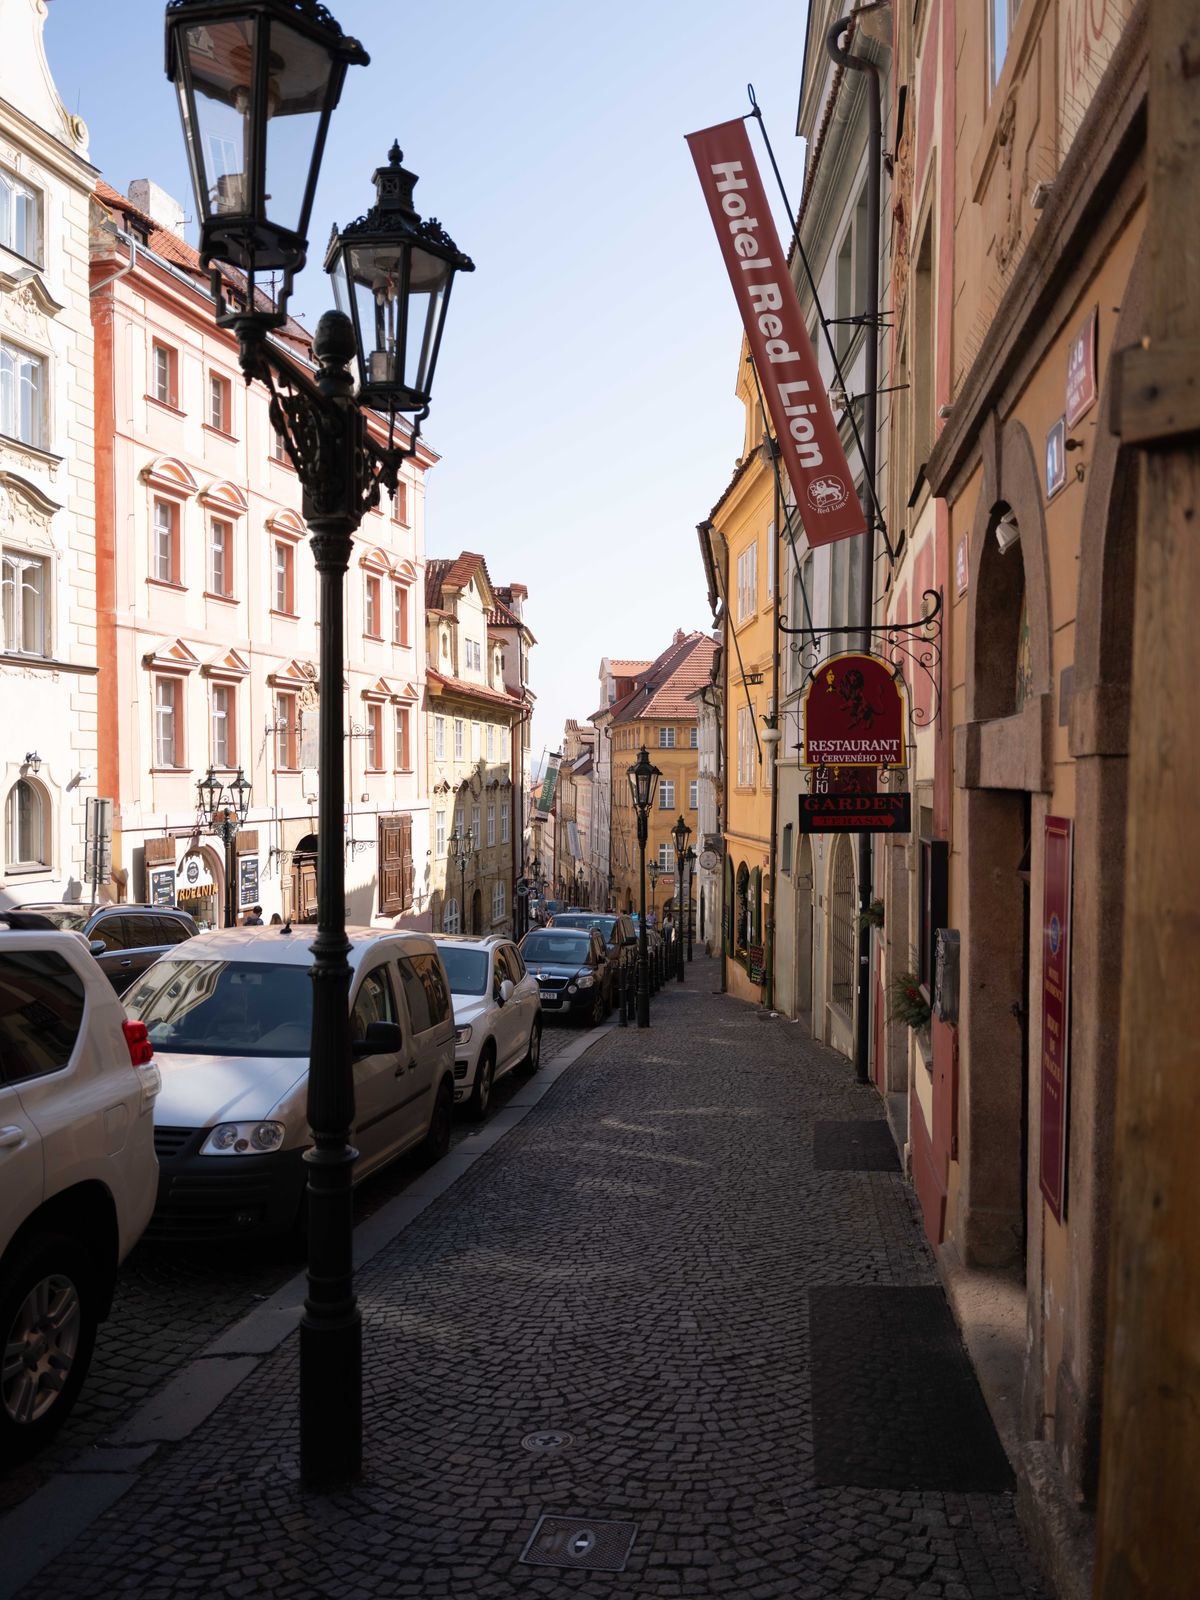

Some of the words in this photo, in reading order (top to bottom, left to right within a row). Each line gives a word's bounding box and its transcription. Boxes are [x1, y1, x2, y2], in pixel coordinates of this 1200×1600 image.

[711, 161, 772, 270] Hotel
[748, 283, 801, 363] Red
[777, 380, 824, 468] Lion
[817, 506, 830, 514] Red
[831, 501, 846, 511] Lion
[809, 740, 899, 751] RESTAURANT
[822, 753, 877, 762] ČERVENÉHO
[880, 754, 896, 762] LVA
[804, 798, 904, 810] GARDEN
[820, 816, 884, 825] TERASA
